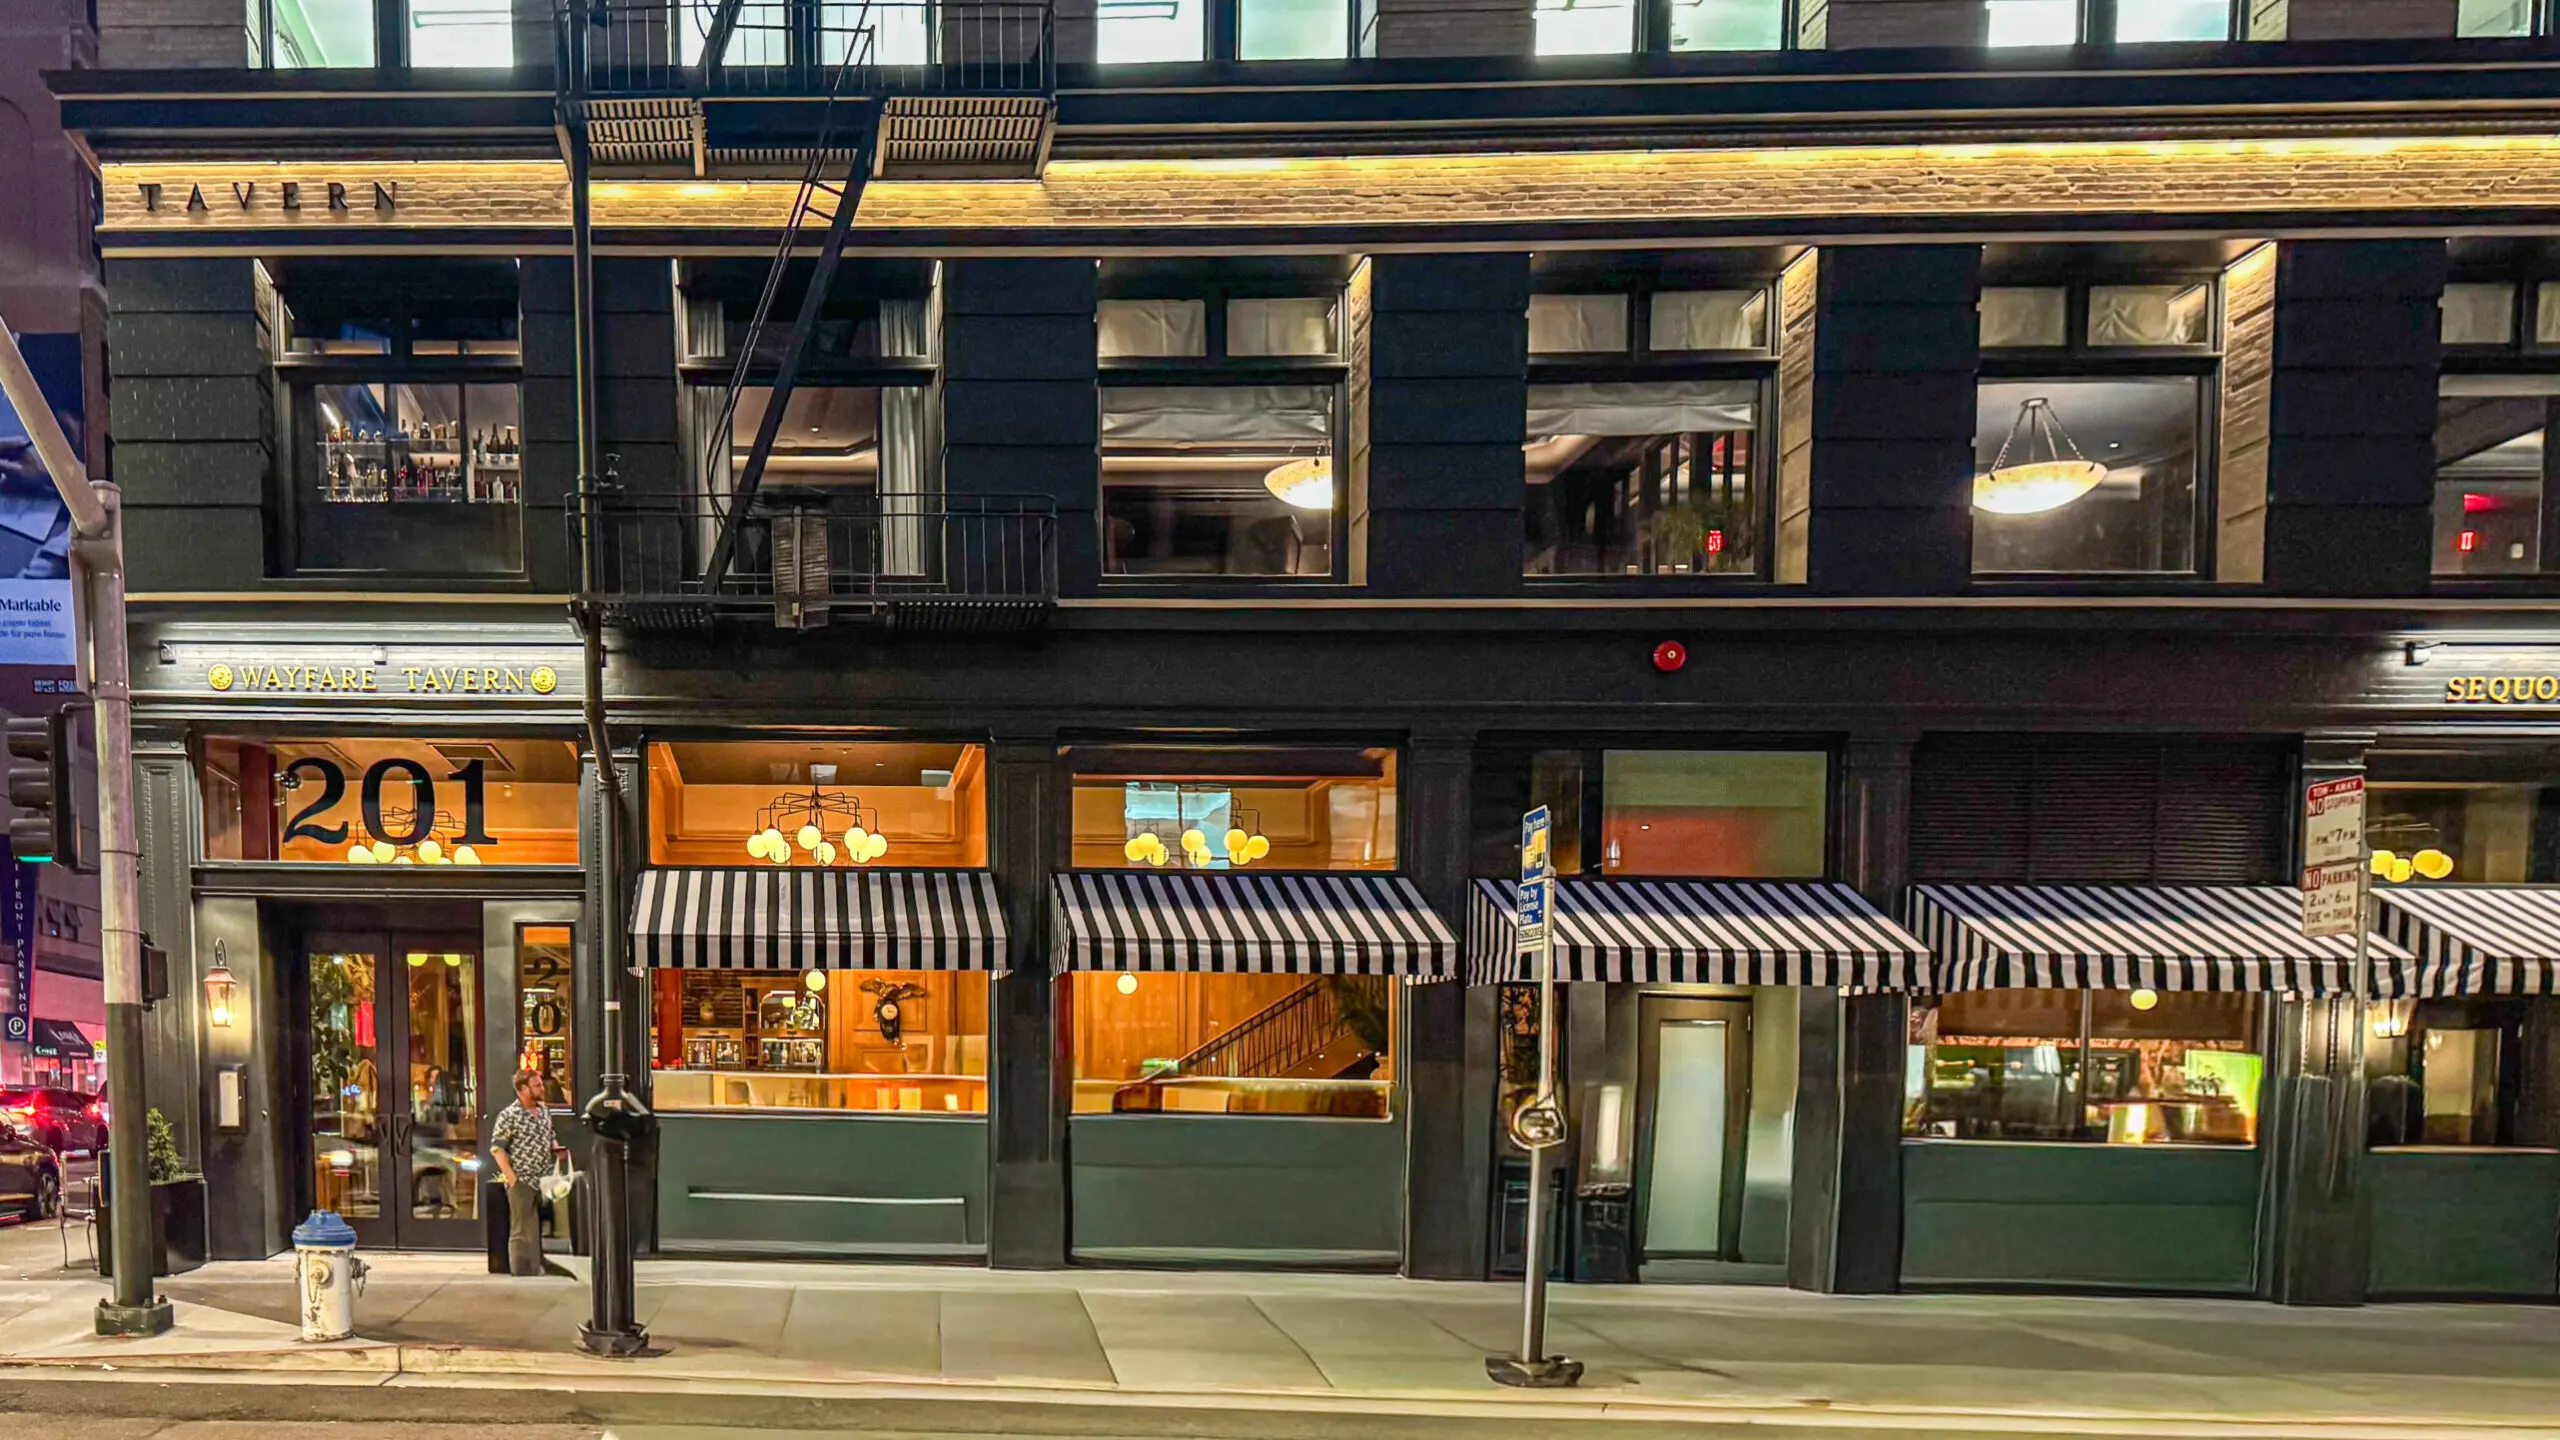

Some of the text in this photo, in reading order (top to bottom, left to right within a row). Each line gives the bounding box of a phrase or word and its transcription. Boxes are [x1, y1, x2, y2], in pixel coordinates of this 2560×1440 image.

[138, 182, 397, 212] TAVERN
[0, 599, 61, 612] Markable
[238, 666, 525, 691] WAYFARE TAVERN
[2445, 675, 2560, 703] SEQUO
[282, 757, 498, 845] 201
[2307, 798, 2324, 816] NO
[2304, 870, 2356, 889] NO PARKING
[1520, 886, 1538, 901] Pay by
[17, 938, 27, 1013] PARKING
